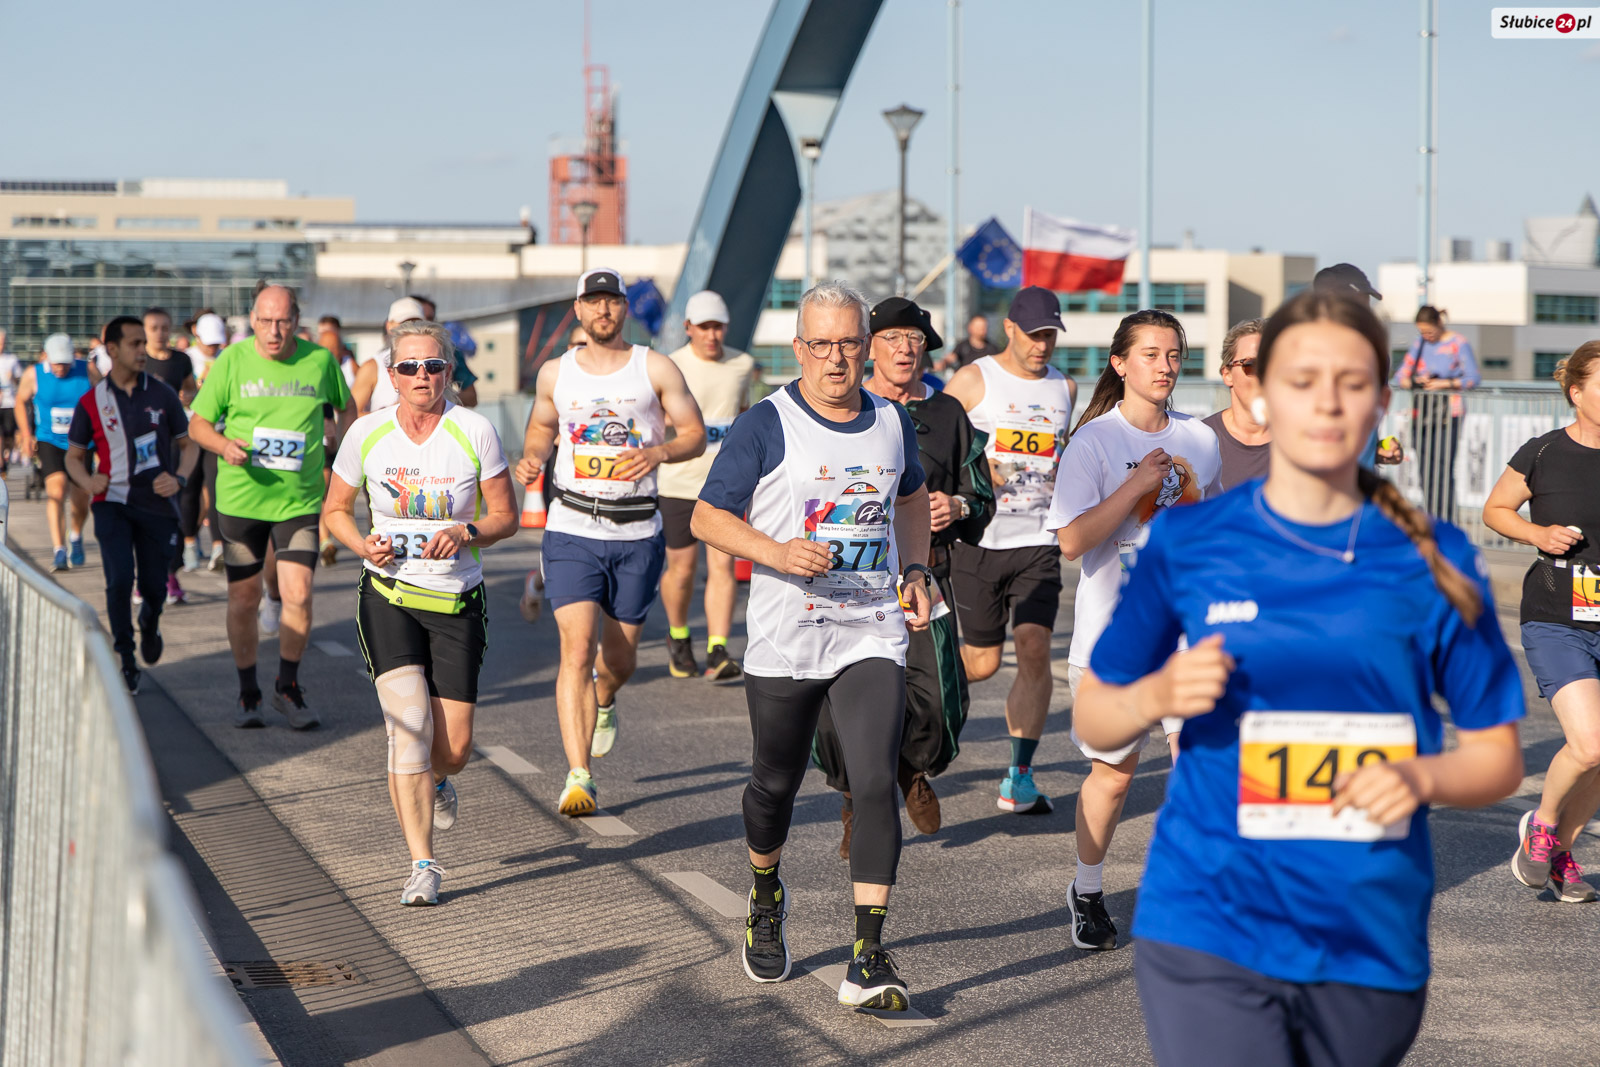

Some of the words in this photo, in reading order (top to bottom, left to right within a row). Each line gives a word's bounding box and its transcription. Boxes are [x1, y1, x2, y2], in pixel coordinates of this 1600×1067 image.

[257, 438, 298, 459] 232
[1011, 431, 1039, 454] 26
[385, 467, 420, 482] BOHLIG
[588, 457, 617, 478] 97
[403, 476, 455, 486] Lauf-Team
[1204, 600, 1259, 625] JAKO
